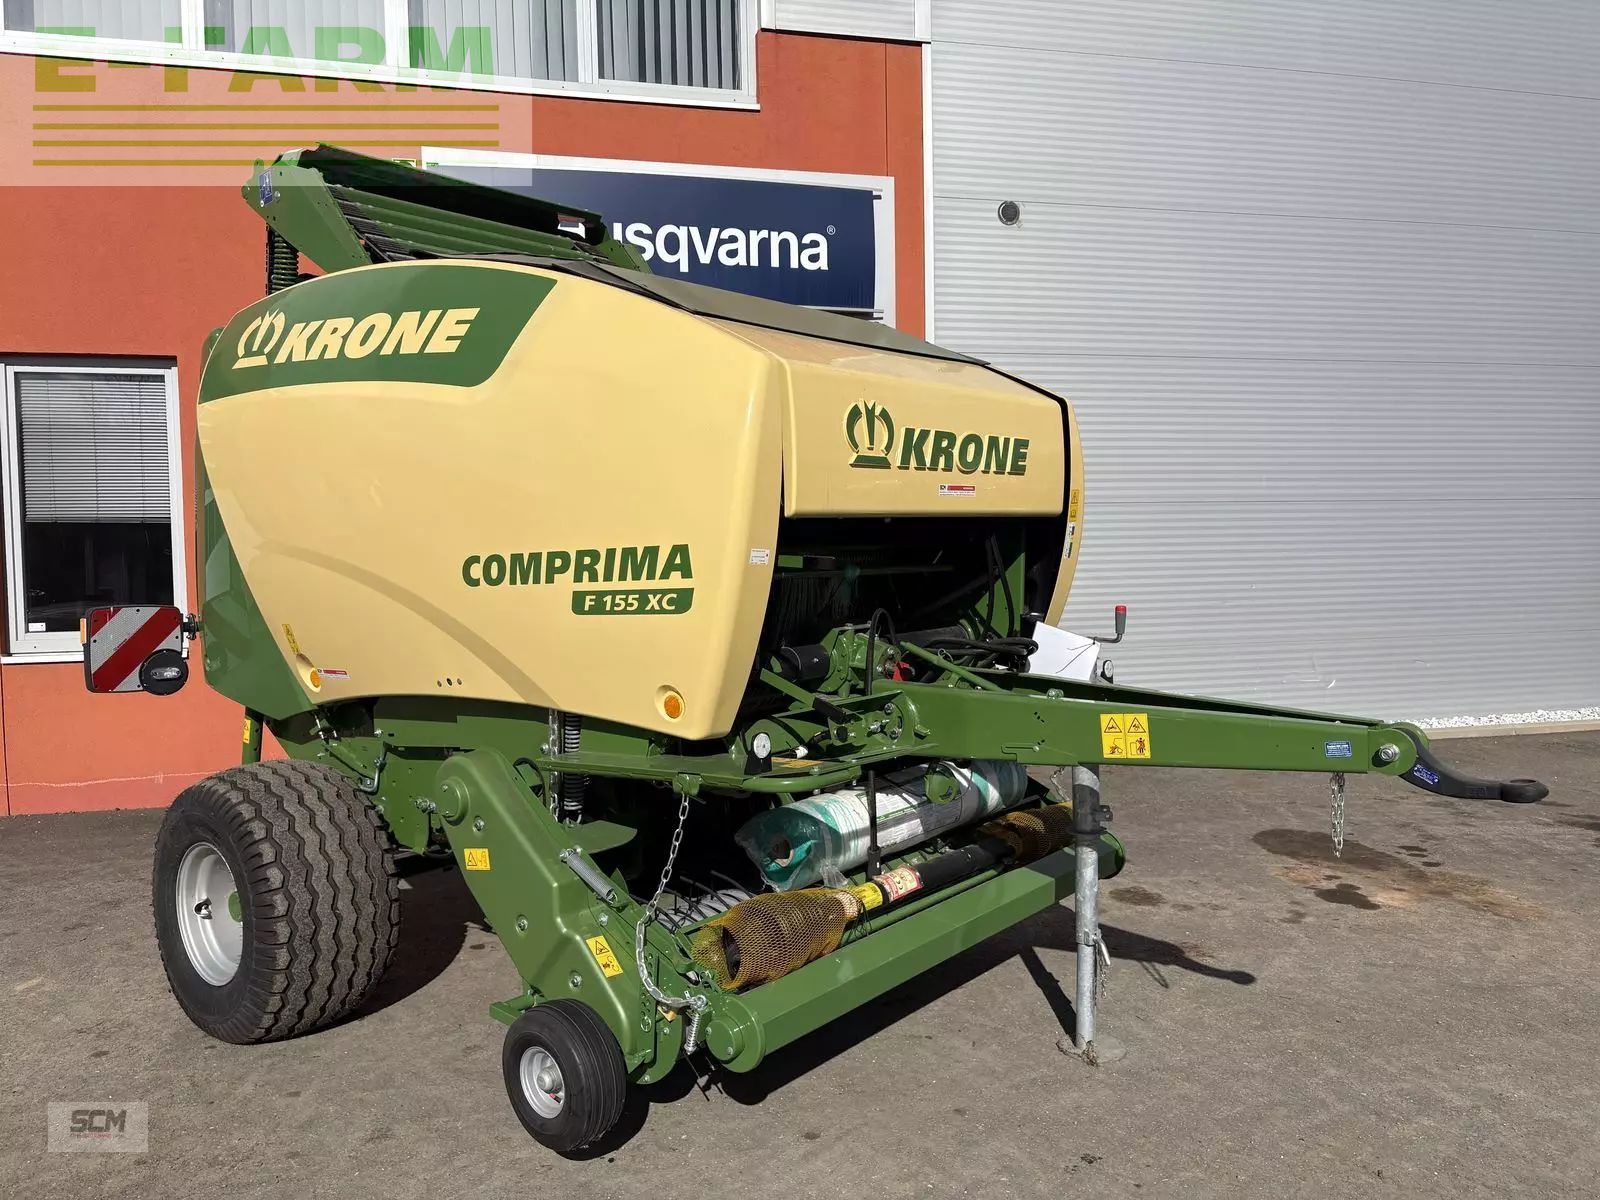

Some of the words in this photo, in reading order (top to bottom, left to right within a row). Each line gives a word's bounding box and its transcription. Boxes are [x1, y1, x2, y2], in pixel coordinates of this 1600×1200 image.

[274, 308, 480, 363] KRONE
[898, 428, 1029, 475] KRONE
[462, 544, 693, 587] COMPRIMA
[585, 595, 596, 611] F
[602, 594, 640, 611] 155
[645, 593, 678, 611] XC
